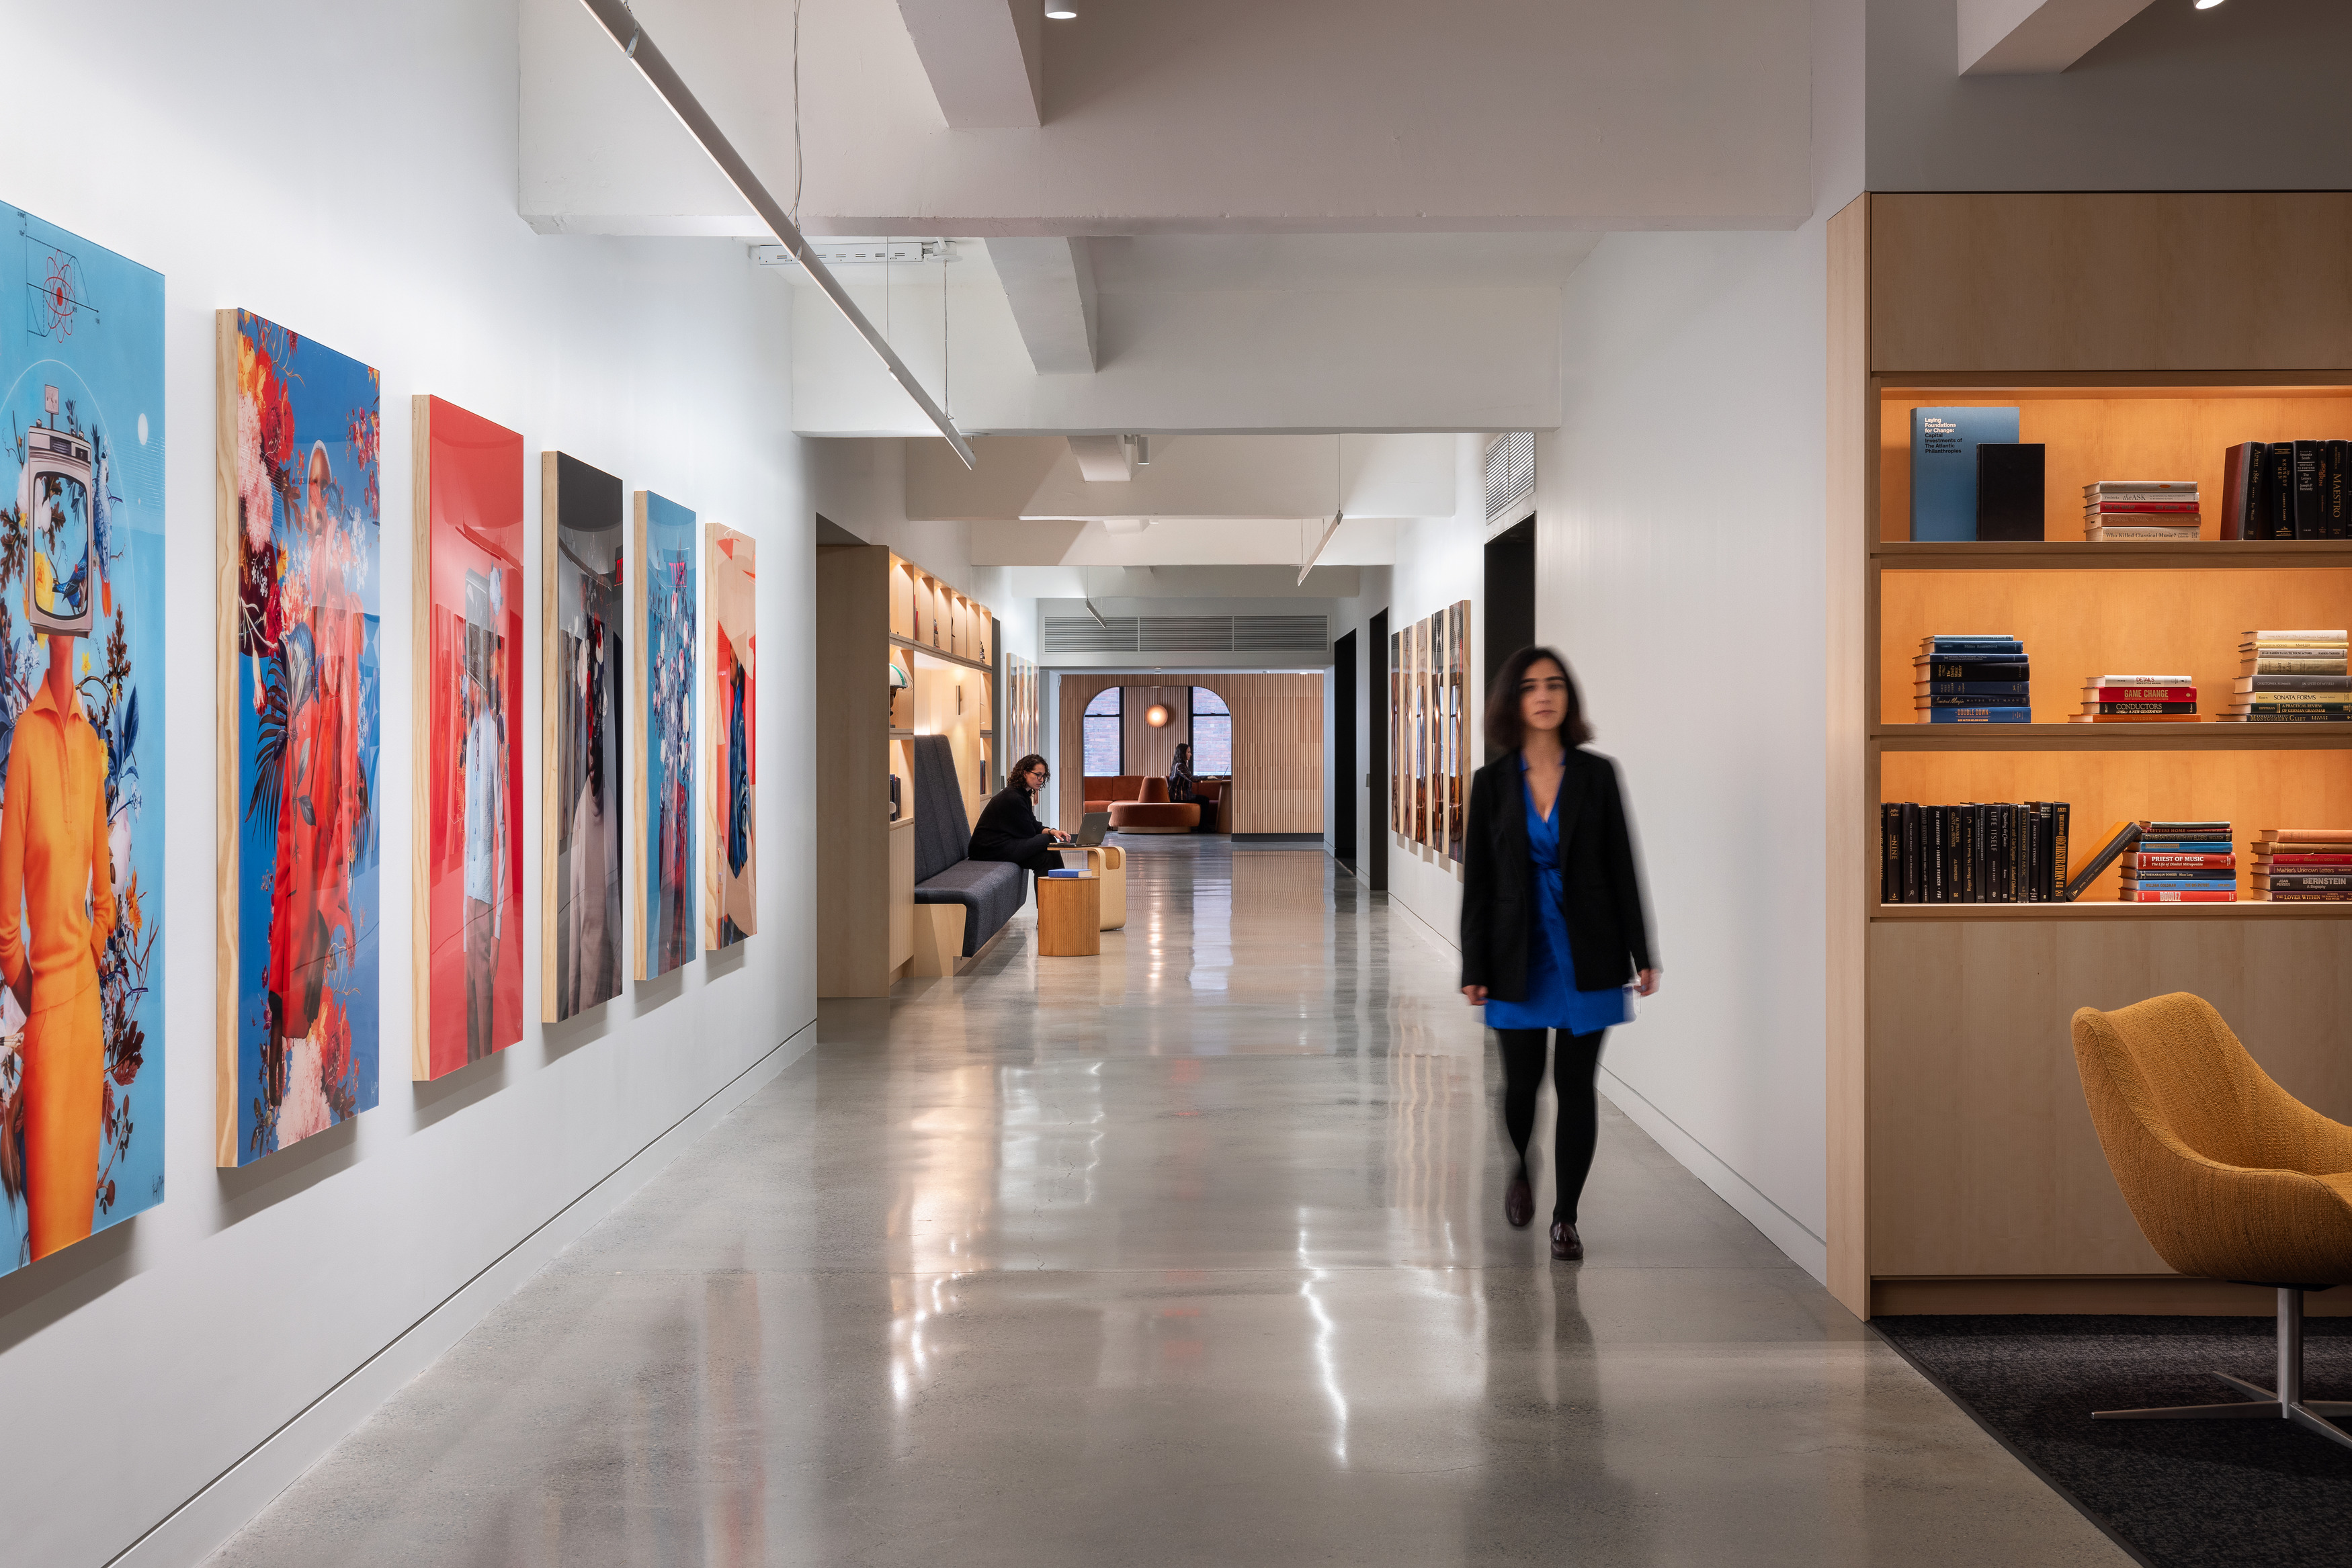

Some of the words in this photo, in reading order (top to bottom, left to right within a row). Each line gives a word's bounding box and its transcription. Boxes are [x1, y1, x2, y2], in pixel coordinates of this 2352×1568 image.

[2333, 474, 2342, 517] MAESTRO
[2022, 852, 2026, 860] ON
[2055, 836, 2066, 880] ORCHESTRATION
[2160, 892, 2181, 902] BOULEZ
